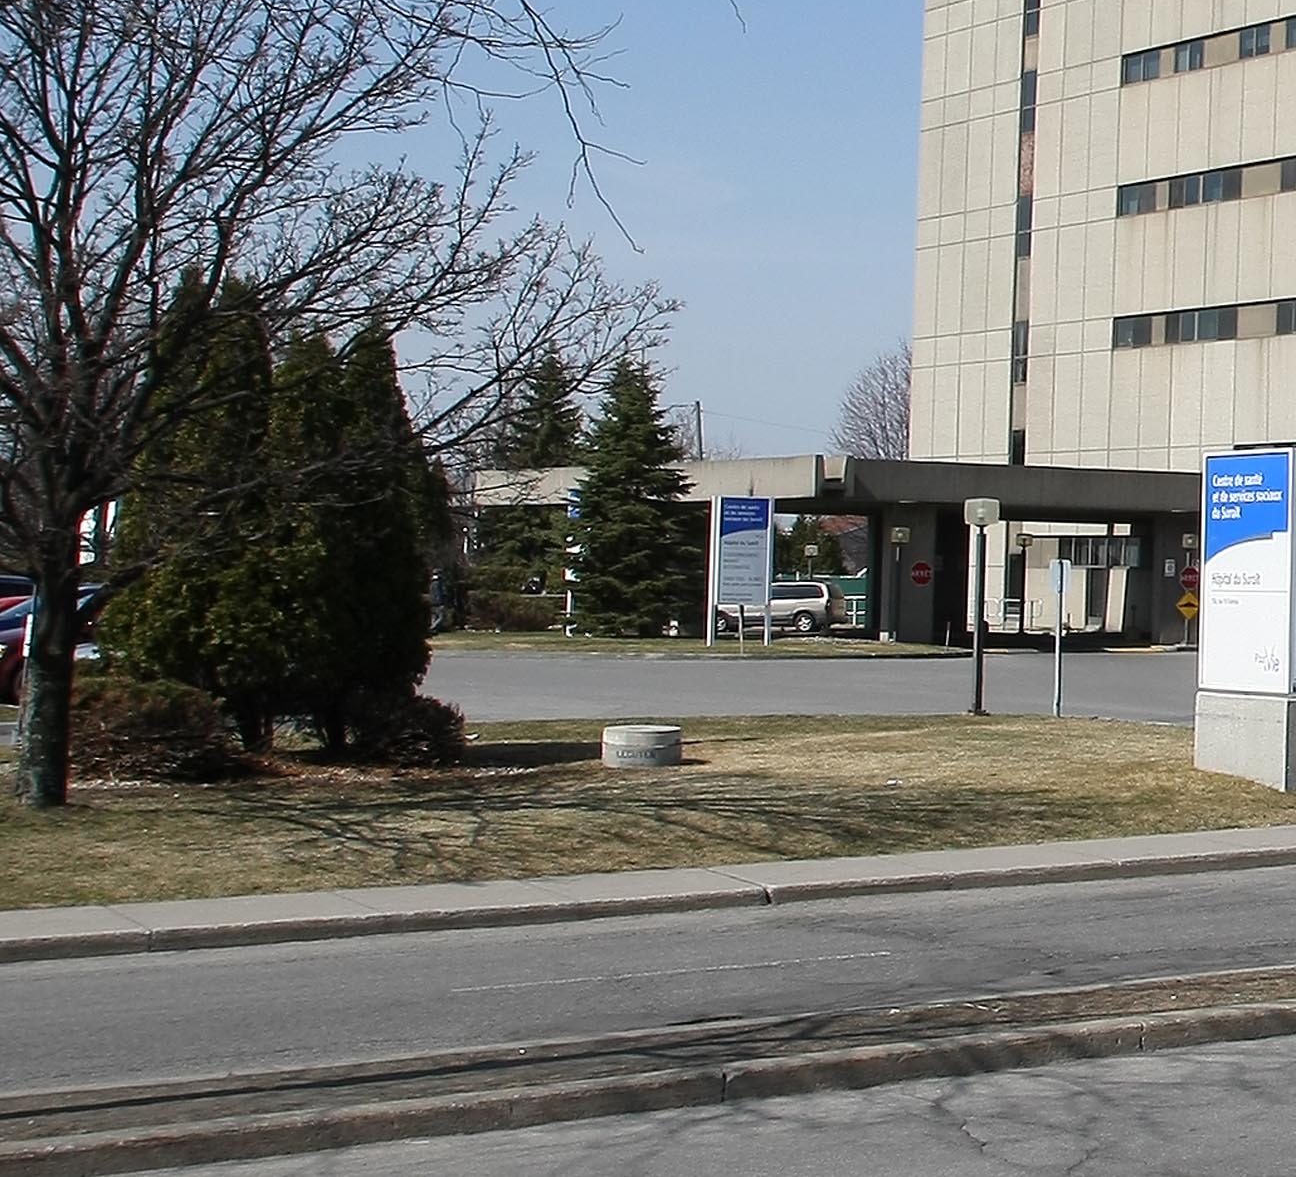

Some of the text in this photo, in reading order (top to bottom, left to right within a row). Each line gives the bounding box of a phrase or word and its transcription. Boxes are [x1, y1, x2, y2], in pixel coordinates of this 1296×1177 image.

[1212, 474, 1233, 487] Centre
[1234, 474, 1243, 486] de
[1212, 488, 1283, 503] et de services sociaux
[1211, 506, 1220, 519] du
